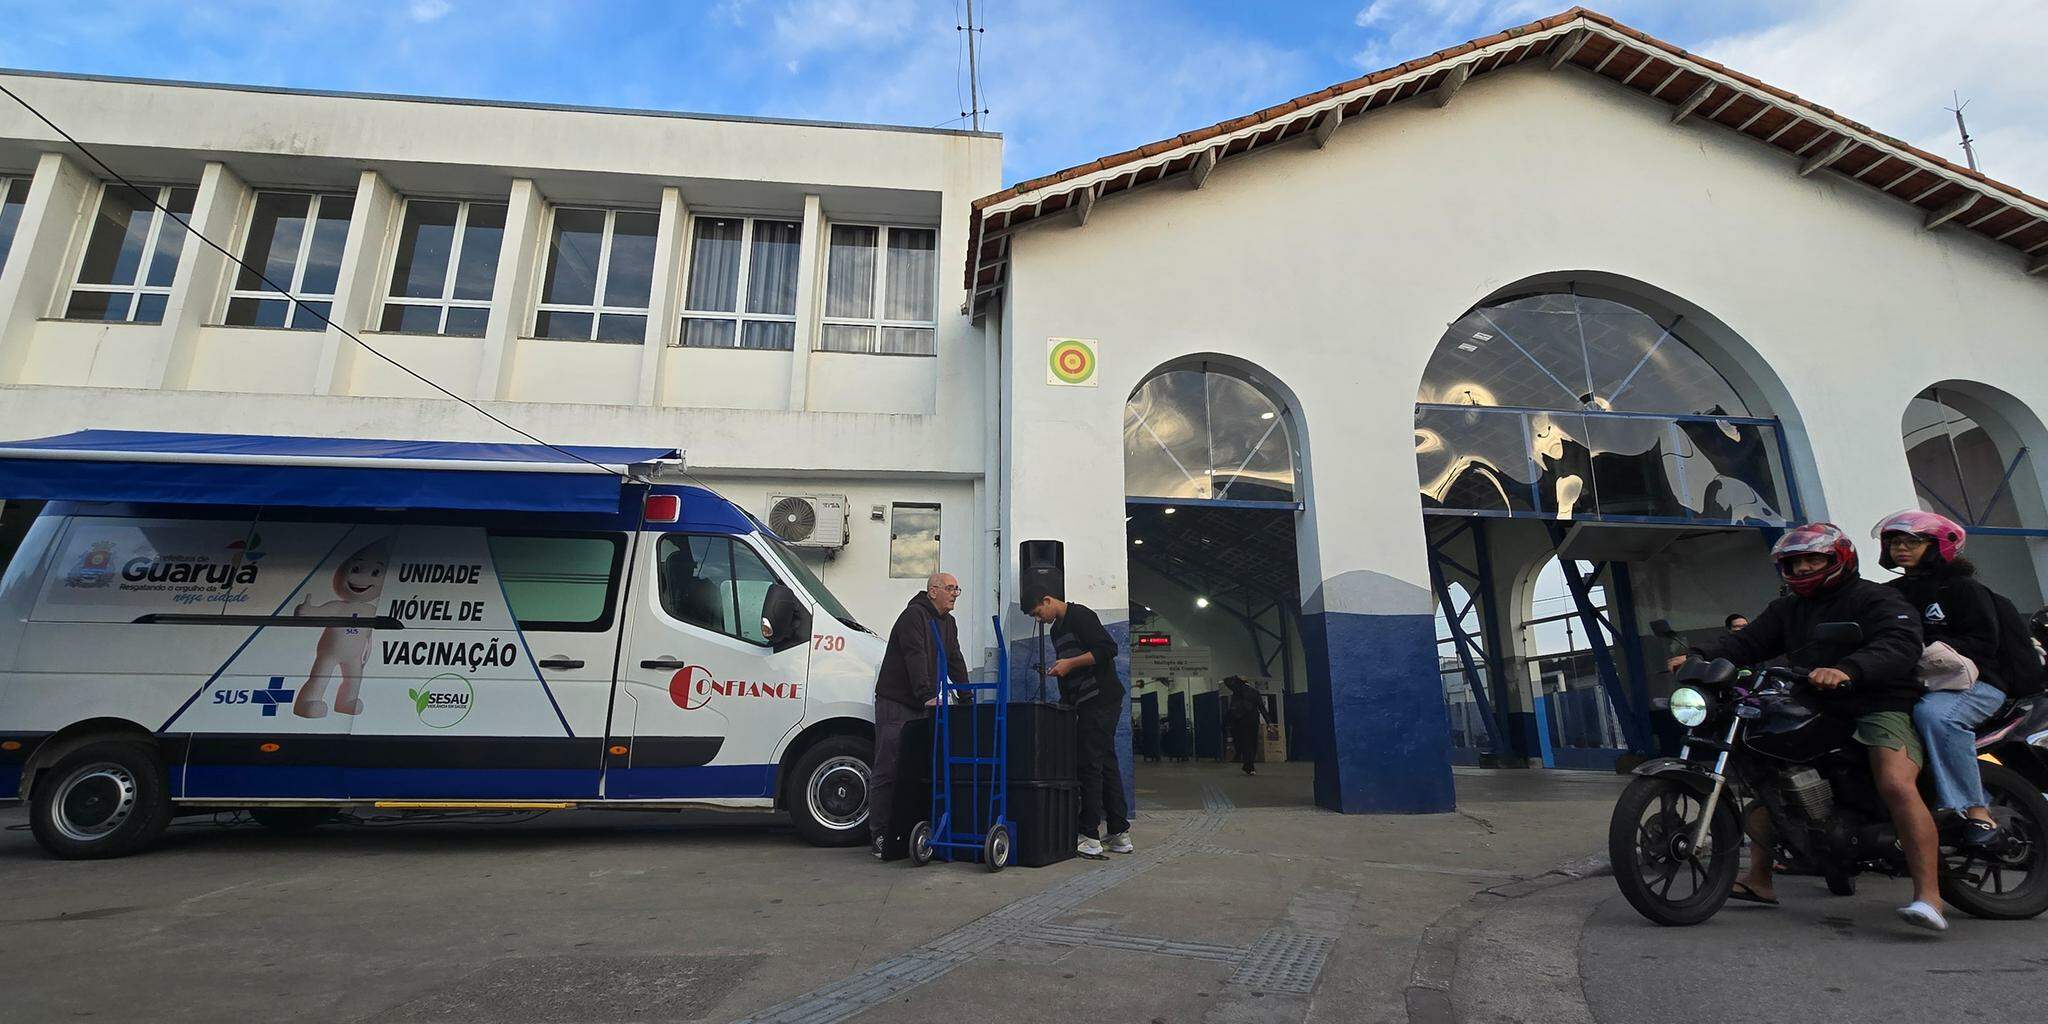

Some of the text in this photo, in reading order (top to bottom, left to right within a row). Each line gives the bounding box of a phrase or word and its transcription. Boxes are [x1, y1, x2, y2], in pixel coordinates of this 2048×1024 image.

[121, 556, 259, 590] Guarujá
[398, 563, 482, 584] UNIDADE
[174, 584, 205, 593] orgulho
[389, 595, 485, 621] MÓVEL DE
[813, 634, 846, 651] 730
[382, 637, 517, 672] VACINAÇÃO
[213, 690, 249, 704] SUS
[669, 665, 803, 710] CONFIANCE
[428, 693, 469, 705] SESAU
